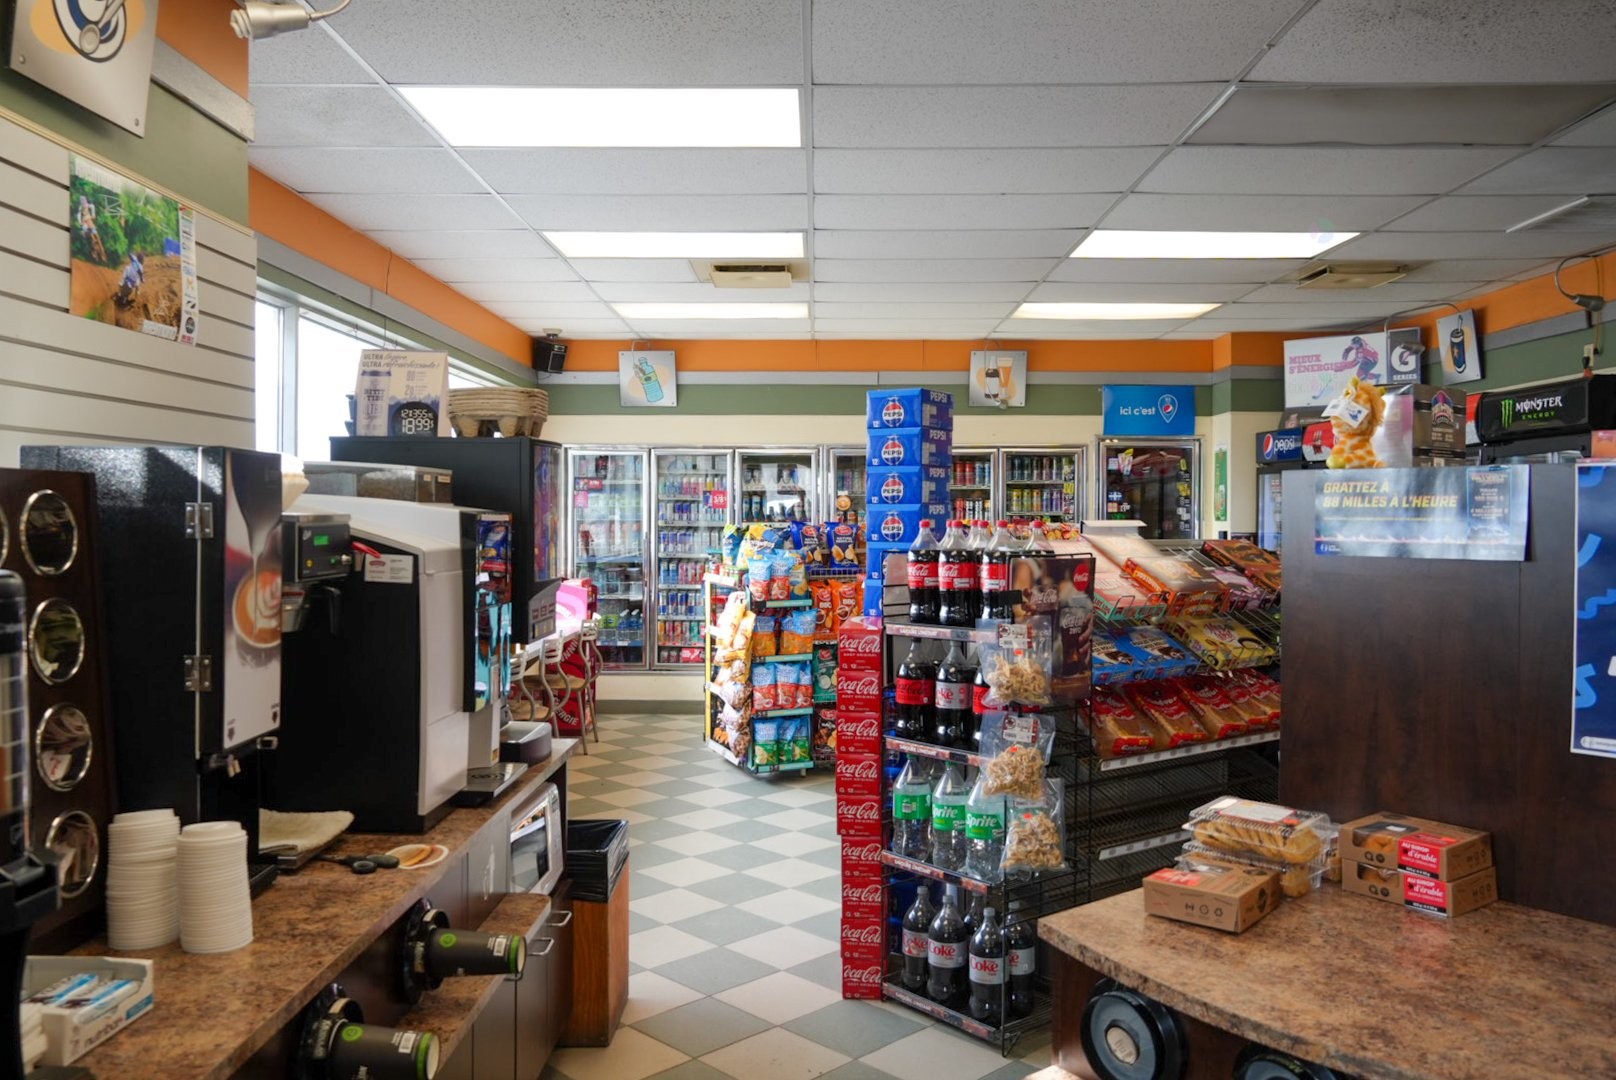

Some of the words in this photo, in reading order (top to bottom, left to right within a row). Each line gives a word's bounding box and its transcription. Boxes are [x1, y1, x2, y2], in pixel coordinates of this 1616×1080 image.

[1289, 354, 1321, 364] MIEUX
[930, 391, 947, 403] PEPSI
[1120, 406, 1132, 415] ici
[1515, 396, 1562, 413] MONSTER
[929, 430, 947, 440] PEPSI
[1273, 436, 1295, 454] pepsi
[929, 468, 946, 478] PEPSI
[1323, 482, 1377, 493] GRATTEZ
[1380, 479, 1390, 493] À
[1342, 496, 1387, 507] MILLES
[1402, 495, 1458, 507] L'HEURE
[929, 504, 945, 514] PEPSI
[966, 813, 997, 828] Sprite
[928, 940, 956, 957] Coke
[970, 955, 998, 972] Coke
